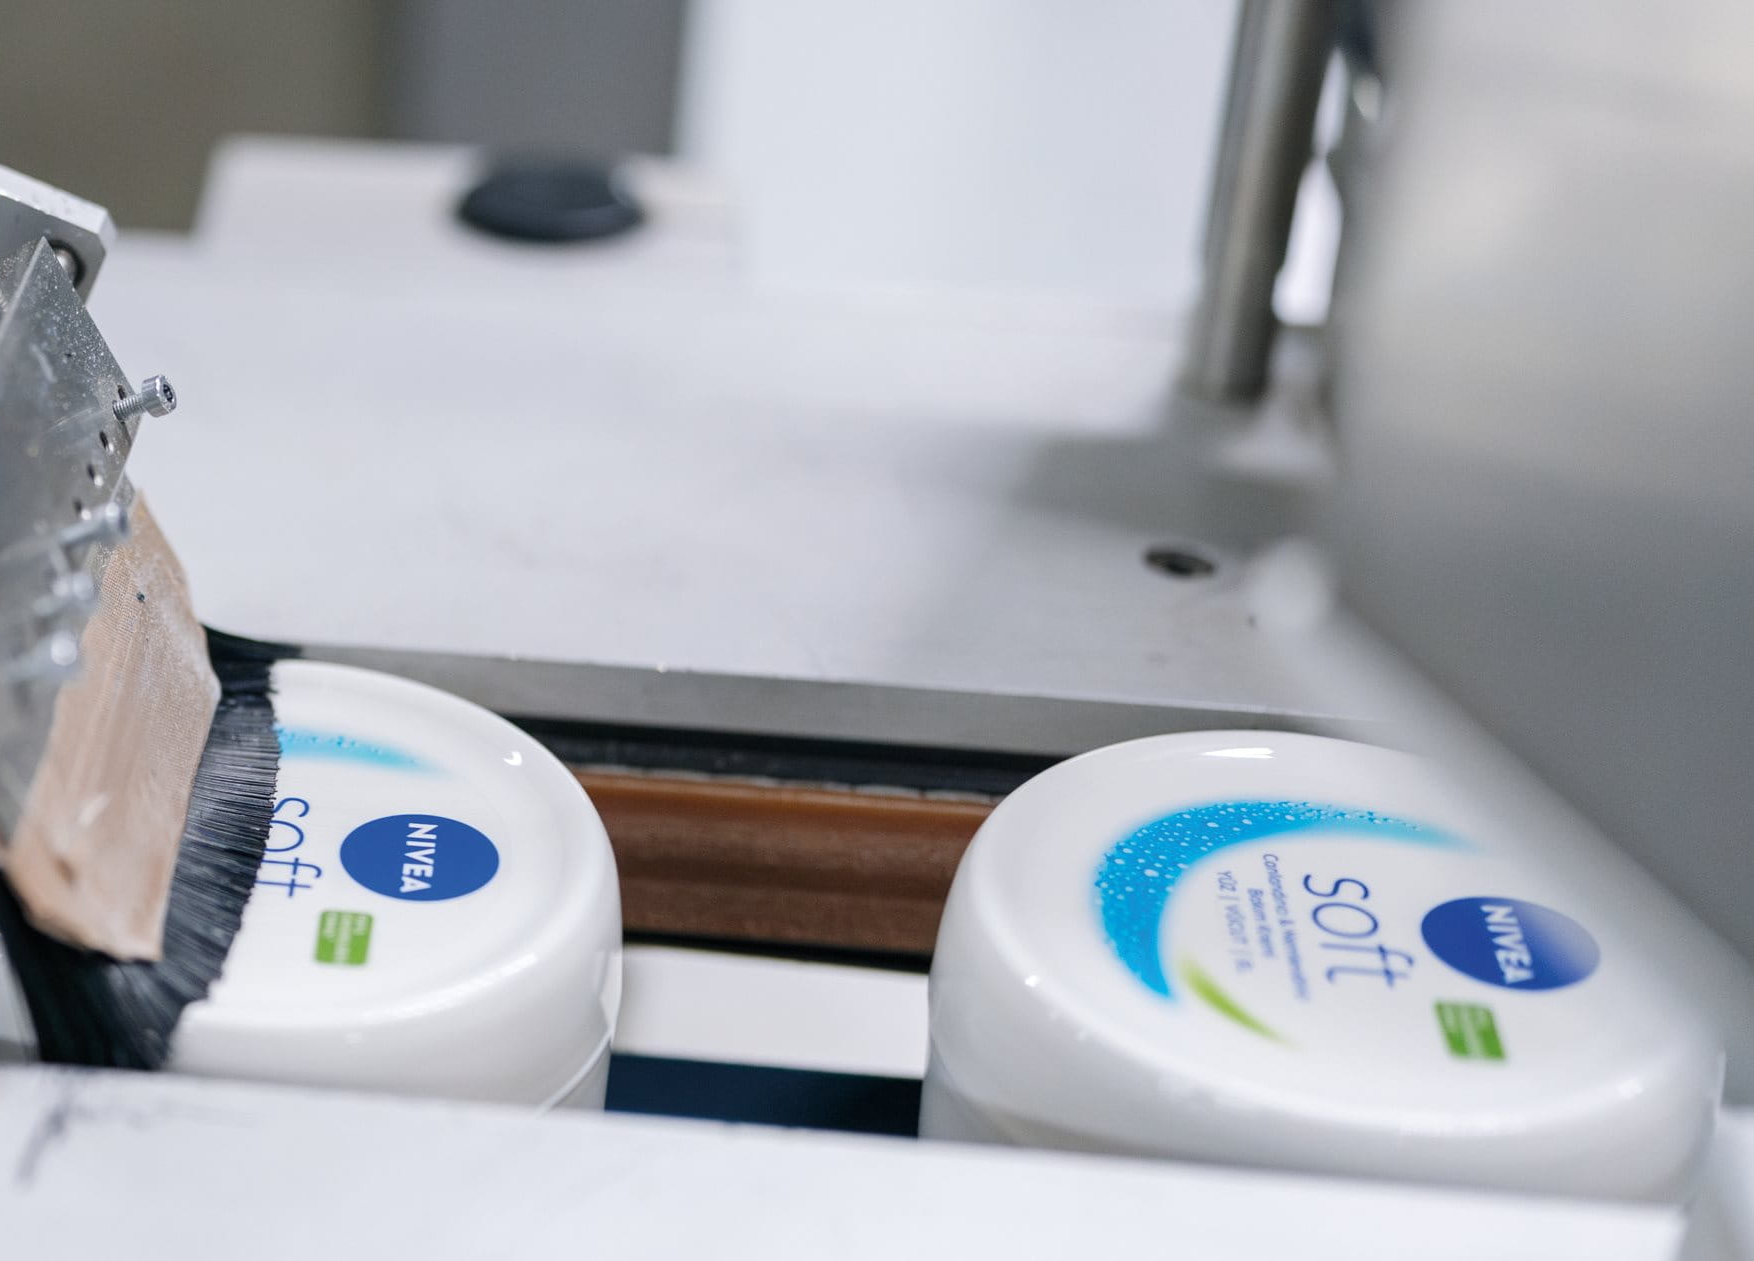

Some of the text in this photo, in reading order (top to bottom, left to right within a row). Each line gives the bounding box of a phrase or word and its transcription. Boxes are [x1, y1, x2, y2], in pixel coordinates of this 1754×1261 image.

[254, 797, 322, 898] soft
[400, 822, 439, 893] NIVEA
[1303, 873, 1415, 988] soft
[1481, 904, 1535, 985] NIVEA
